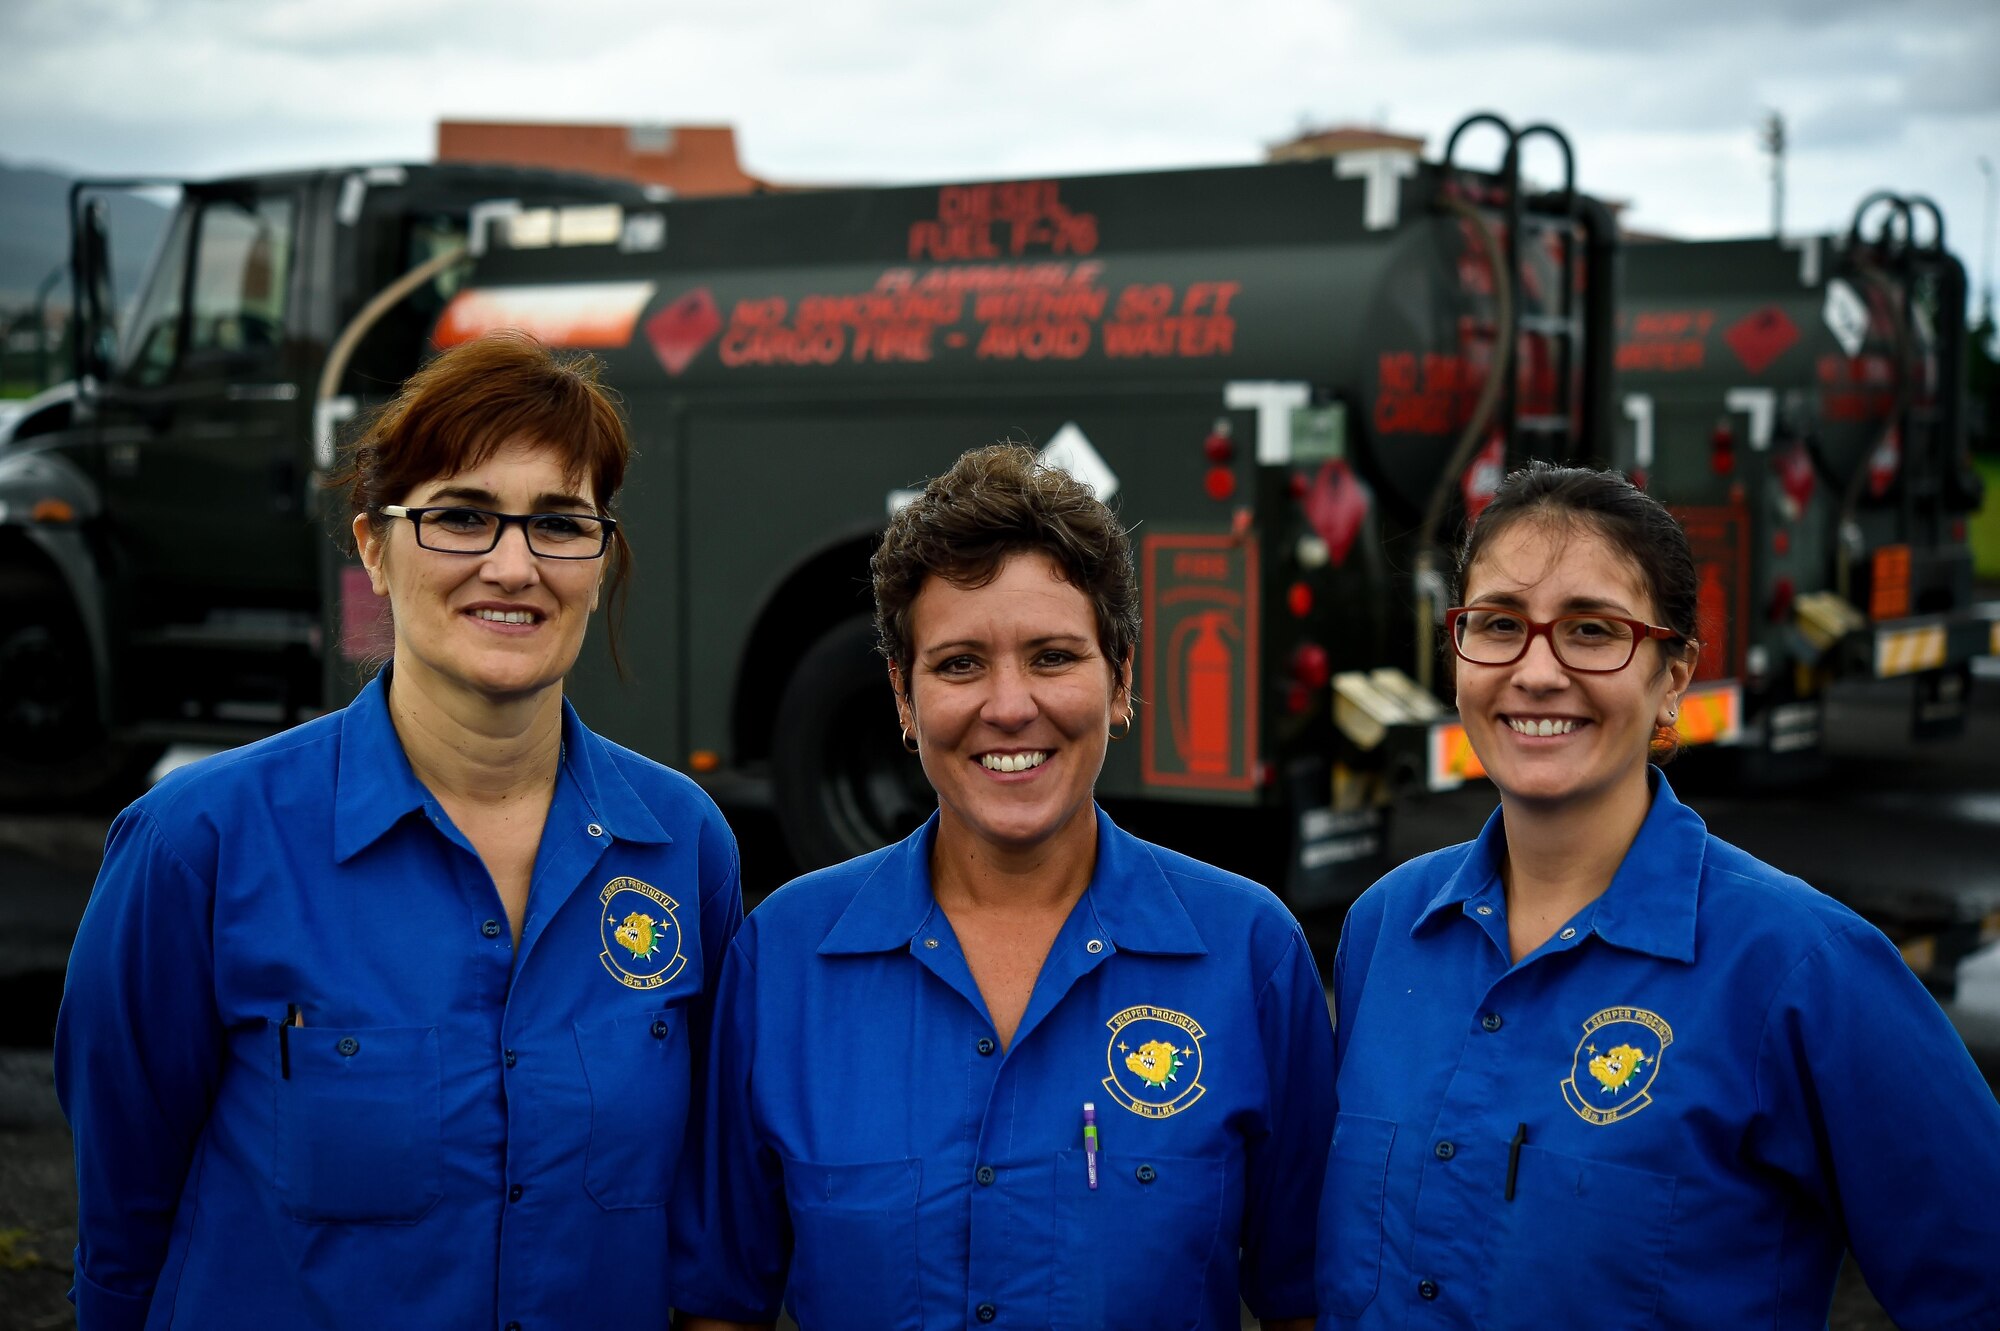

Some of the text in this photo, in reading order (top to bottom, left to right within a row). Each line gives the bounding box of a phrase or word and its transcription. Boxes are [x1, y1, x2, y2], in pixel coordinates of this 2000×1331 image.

[938, 180, 1066, 222] DIESEL
[908, 217, 999, 262] FUEL
[730, 297, 788, 329] NO
[795, 290, 964, 327] SMOKING
[973, 287, 1109, 323] WITHIN
[1181, 280, 1242, 318] FT
[719, 326, 845, 368] CARGO
[852, 324, 932, 364] FIRE
[976, 320, 1092, 360] AVOID
[1103, 315, 1236, 359] WATER
[604, 879, 672, 907] SEMPER PROCINCTU
[1114, 1008, 1199, 1034] SEMPER PROCINCTU
[1591, 1009, 1632, 1028] SEMPER
